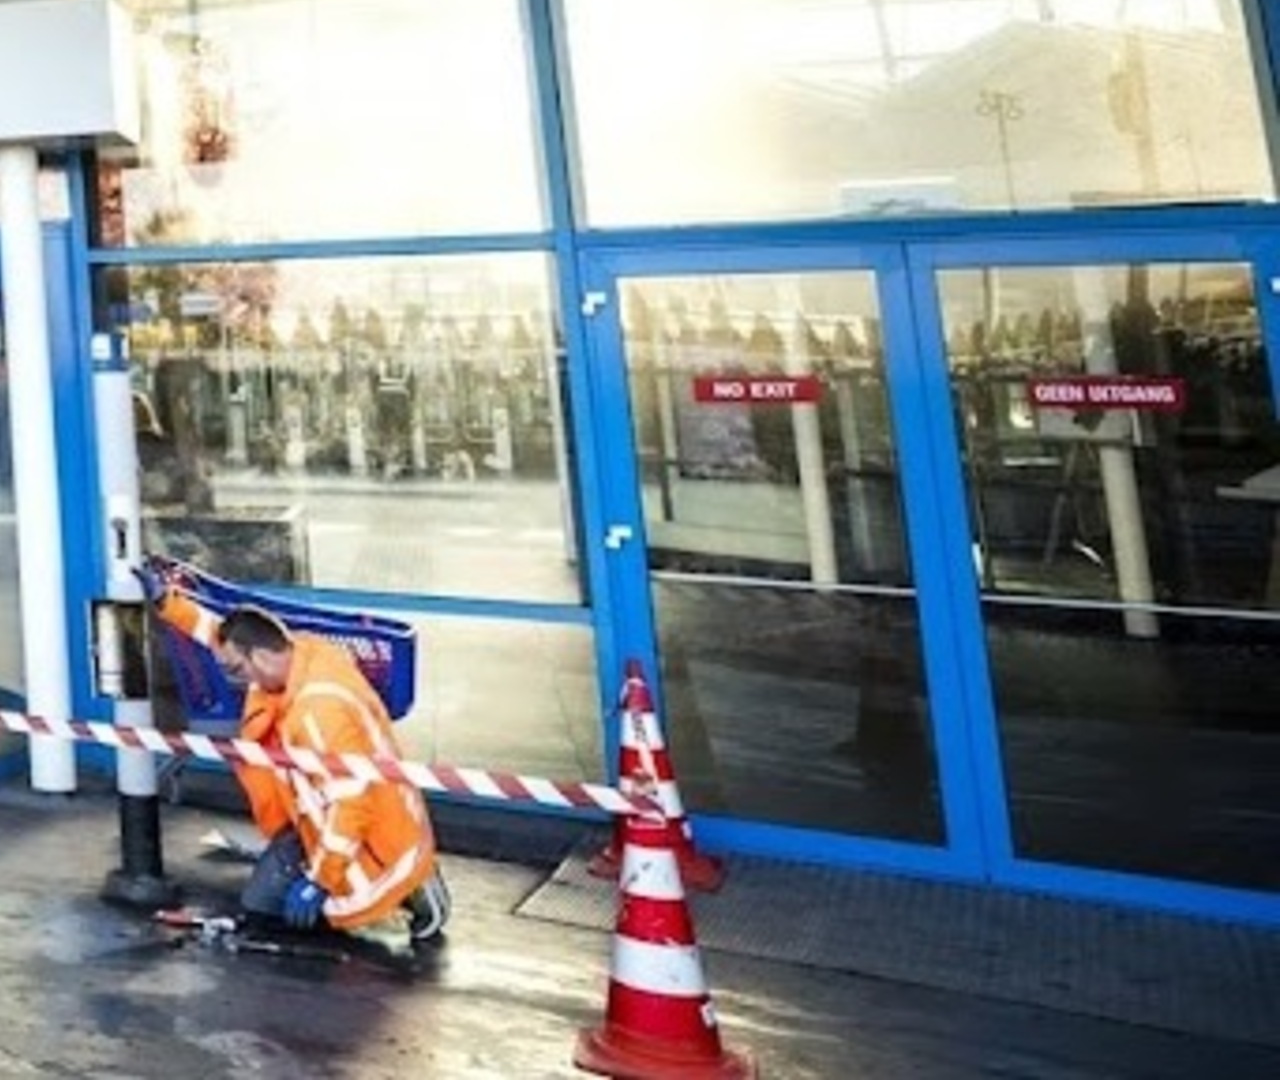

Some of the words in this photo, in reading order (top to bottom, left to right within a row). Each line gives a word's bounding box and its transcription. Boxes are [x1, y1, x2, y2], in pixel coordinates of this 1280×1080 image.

[713, 381, 745, 399] NO
[750, 381, 797, 399] EXIT
[1035, 383, 1085, 402] GEEN
[1089, 384, 1176, 403] UITGANG
